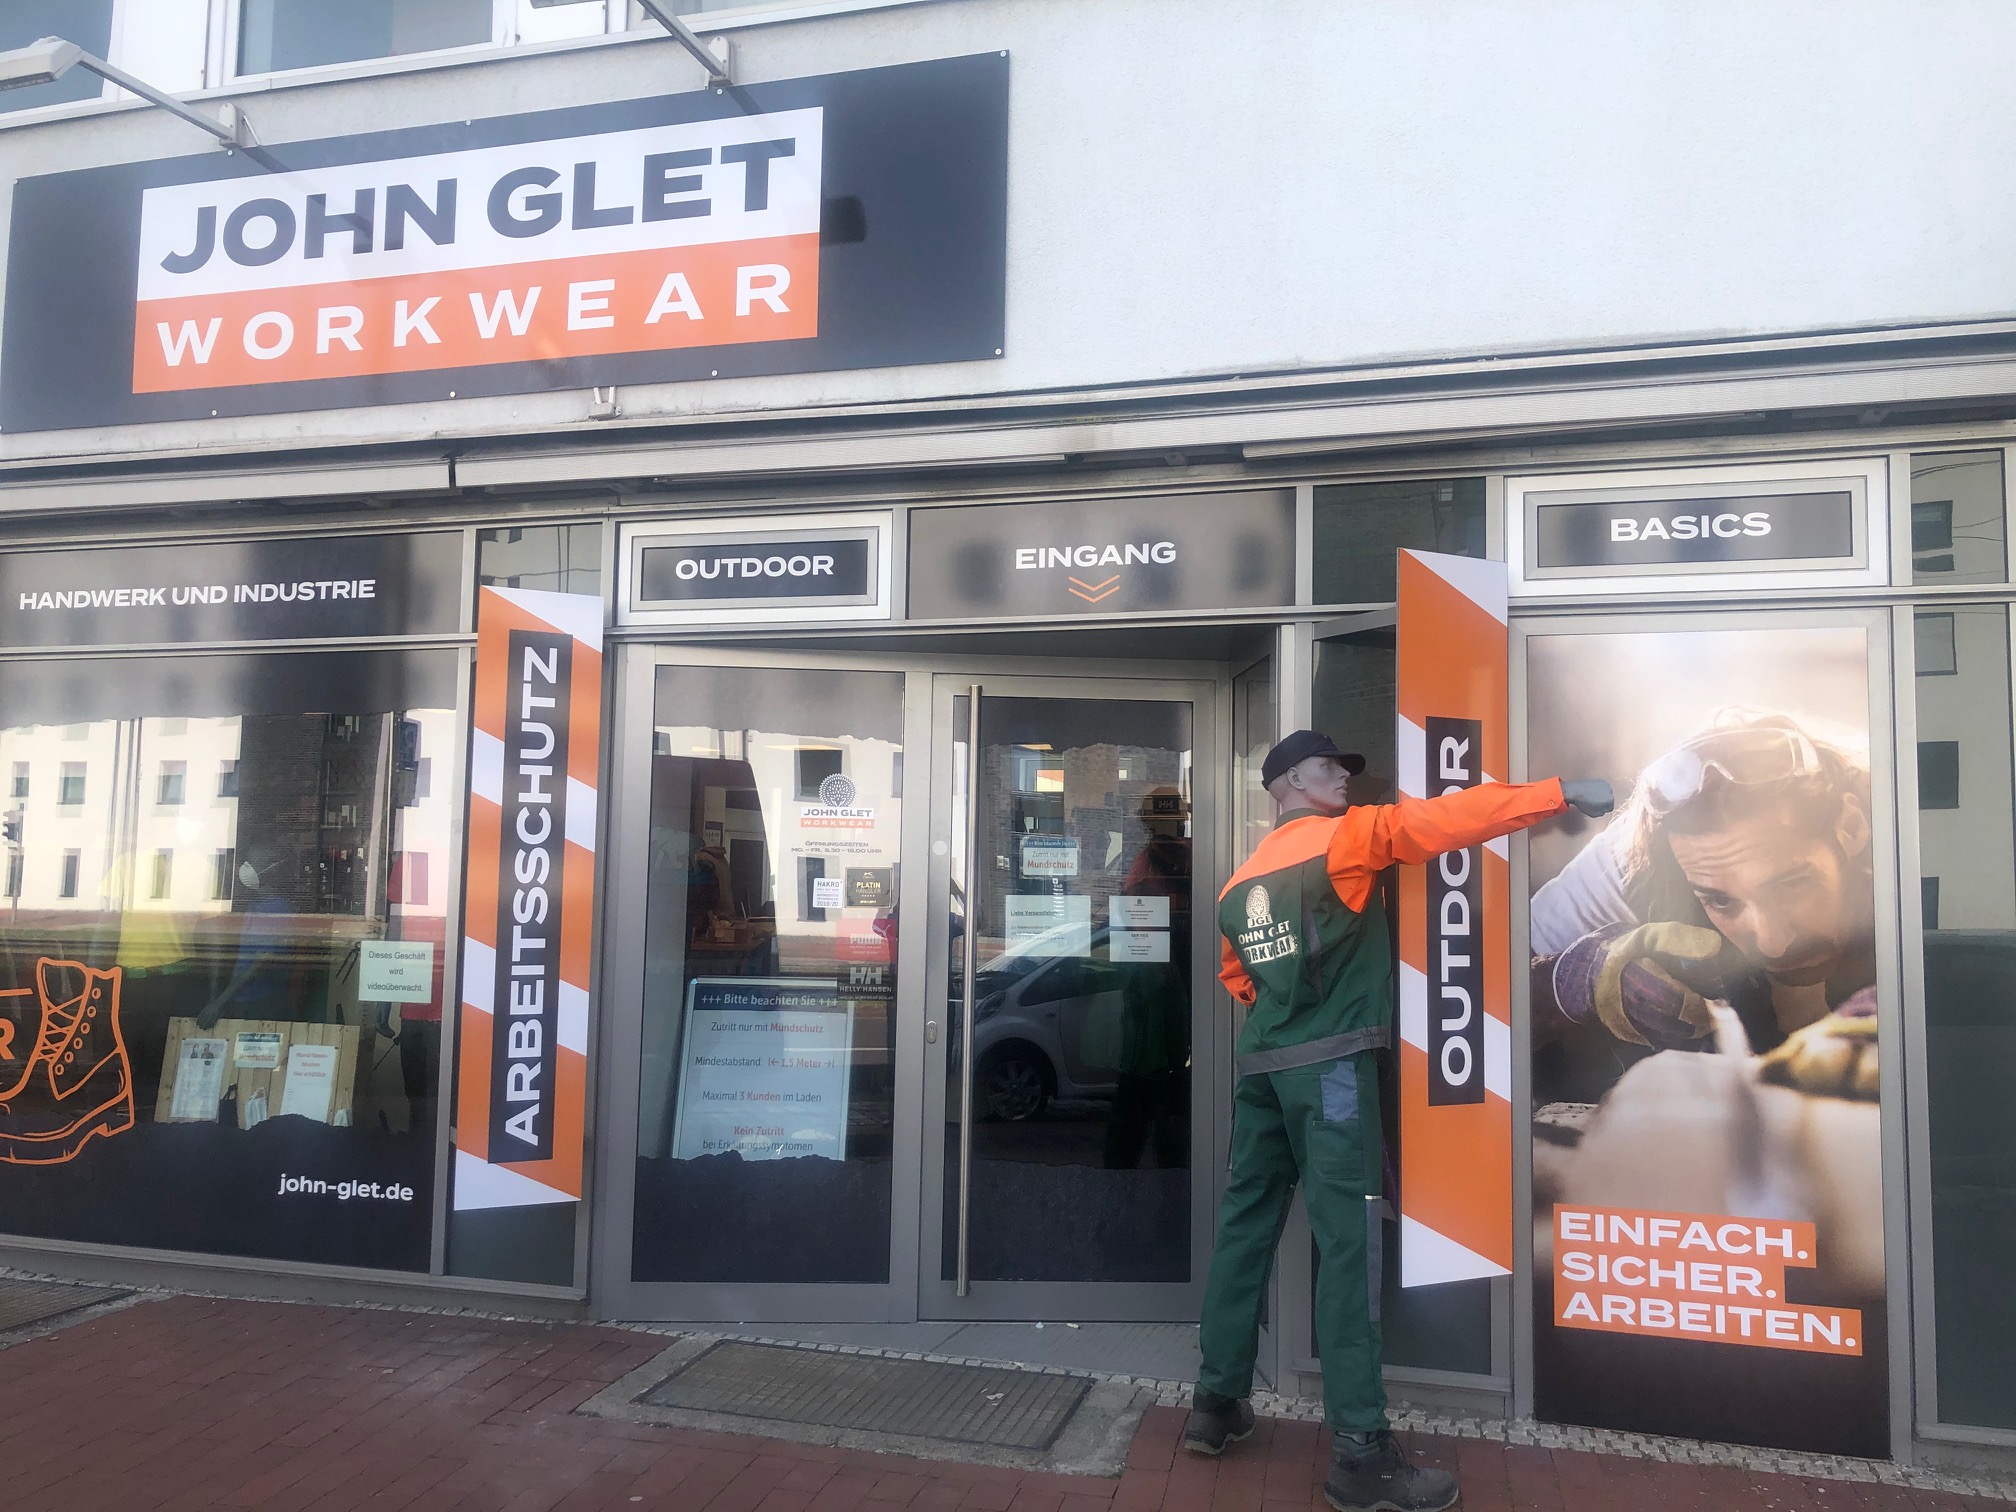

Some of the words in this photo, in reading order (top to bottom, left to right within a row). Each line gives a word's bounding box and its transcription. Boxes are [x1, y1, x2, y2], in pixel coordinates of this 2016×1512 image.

[160, 178, 457, 274] JOHN
[486, 137, 796, 239] GLET
[157, 263, 792, 367] WORKWEAR
[1610, 511, 1772, 542] BASICS
[1015, 540, 1177, 571] EINGANG
[675, 554, 835, 581] OUTDOOR
[19, 587, 167, 610] HANDWERK
[171, 585, 228, 606] UND
[233, 579, 377, 603] INDUSTRIE
[840, 809, 872, 817] GLET
[803, 819, 872, 827] WORKWEAR
[1027, 860, 1074, 869] Mundschutz
[504, 646, 558, 1147] ARBEITSSCHUTZ
[1439, 735, 1472, 1087] OUTDOR
[1251, 916, 1271, 926] JGL
[1238, 929, 1265, 944] OHN
[368, 950, 393, 960] Dieses
[394, 950, 426, 961] Geschäft
[389, 966, 404, 976] wird
[850, 967, 882, 984] HH
[367, 982, 424, 992] videoüberwacht.
[724, 993, 748, 1004] Bitte
[750, 994, 798, 1006] beachten
[801, 995, 816, 1006] Sie
[711, 1021, 736, 1032] Zutritt
[738, 1023, 753, 1032] nur
[754, 1022, 768, 1032] mit
[770, 1023, 824, 1033] Mundschutz
[695, 1056, 763, 1067] Mindestabstand:
[781, 1059, 794, 1069] 1,5
[796, 1058, 822, 1068] Meter
[702, 1090, 738, 1101] Maximal
[739, 1091, 746, 1100] 3
[747, 1091, 780, 1101] Kunden
[783, 1092, 794, 1101] im
[796, 1092, 822, 1102] Laden
[734, 1125, 753, 1135] Kein
[756, 1126, 785, 1136] Zutritt
[702, 1139, 716, 1149] bei
[277, 1173, 414, 1201] john-glet.de
[1560, 1211, 1808, 1260] EINFACH.
[1561, 1251, 1777, 1299] SICHER.
[1562, 1291, 1857, 1347] ARBEITEN.
